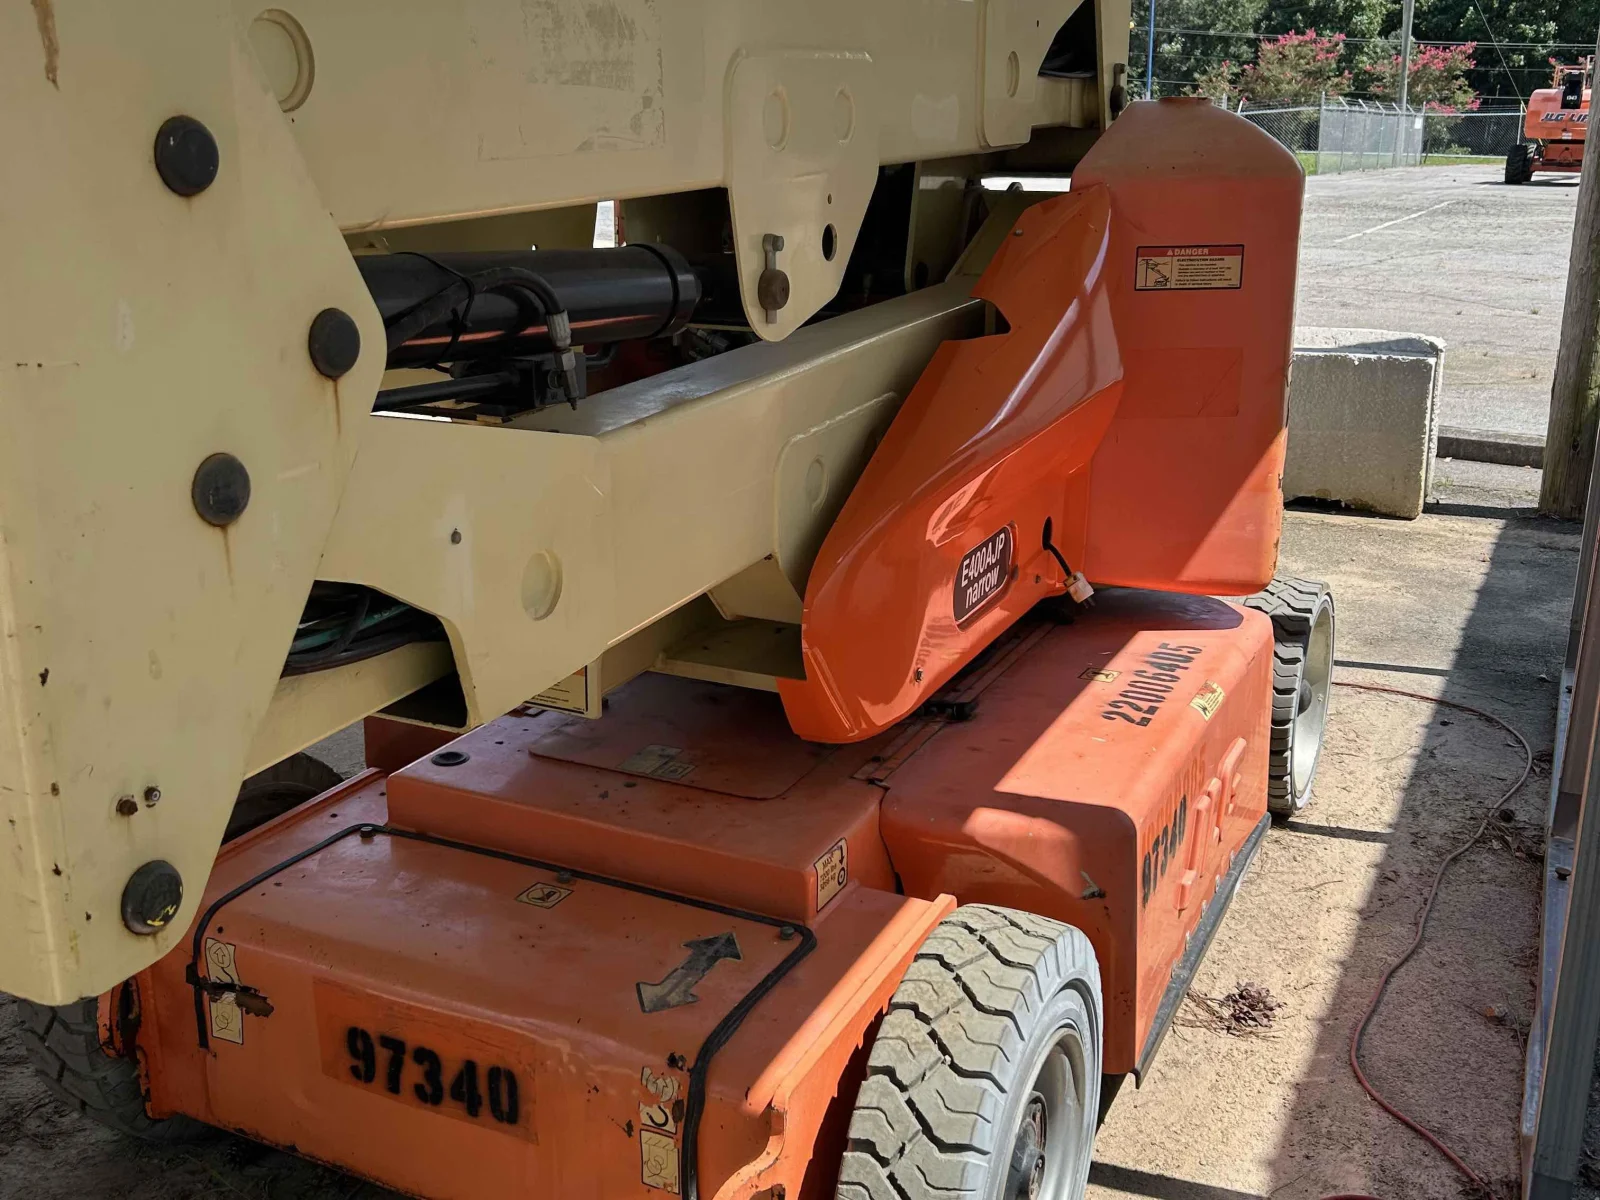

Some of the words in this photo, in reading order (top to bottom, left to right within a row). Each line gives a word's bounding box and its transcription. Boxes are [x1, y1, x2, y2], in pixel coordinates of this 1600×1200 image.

[1541, 113, 1565, 122] JLG
[1569, 113, 1589, 122] LIF
[1174, 248, 1209, 256] DANGER
[961, 532, 1005, 588] E400AJP
[965, 565, 1000, 609] narrow
[1101, 642, 1203, 728] 22006405
[346, 1026, 519, 1125] 97340
